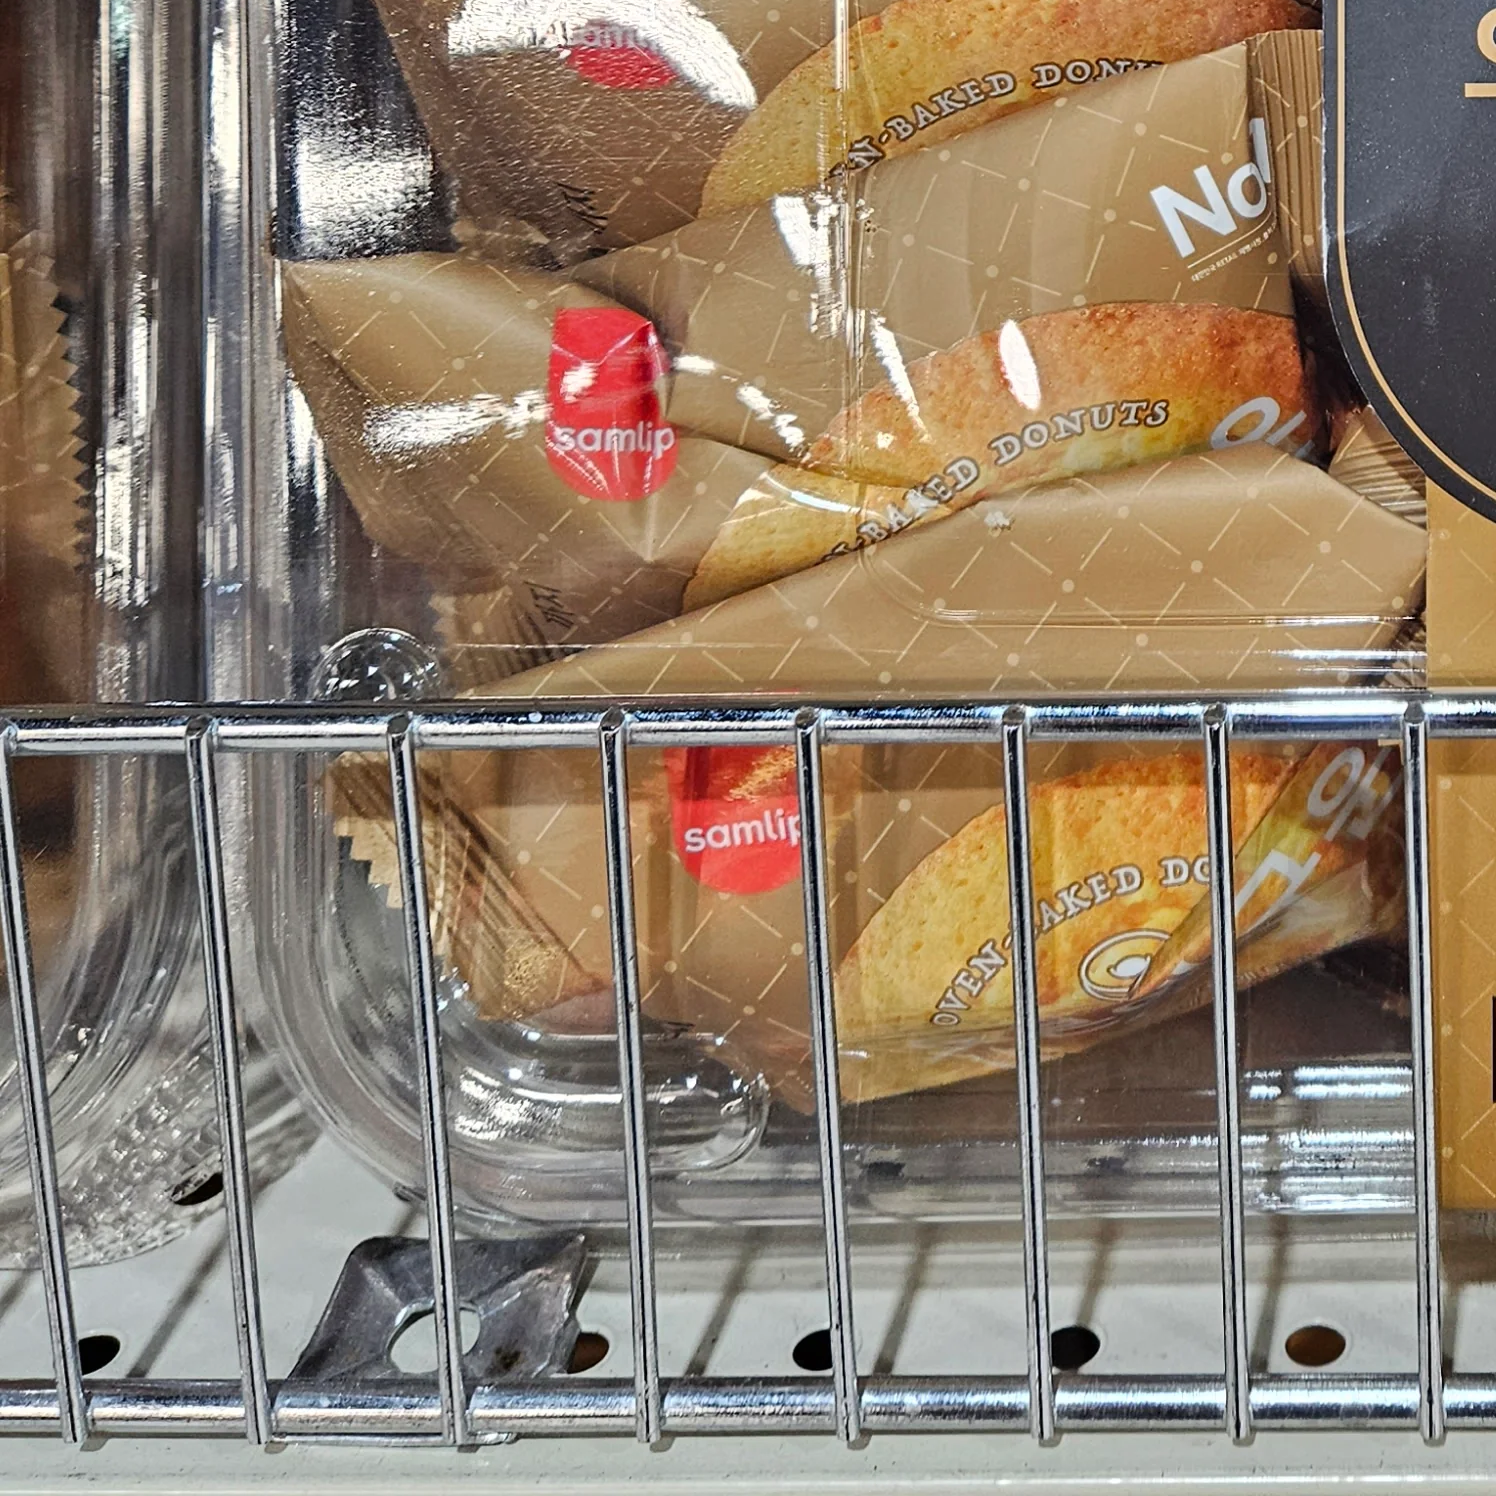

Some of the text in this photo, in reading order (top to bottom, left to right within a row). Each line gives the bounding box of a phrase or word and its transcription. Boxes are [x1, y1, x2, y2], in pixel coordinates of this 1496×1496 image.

[553, 420, 675, 461] samlip
[987, 399, 1170, 467] DONUTS
[683, 807, 801, 853] samlip
[930, 863, 1145, 1028] OVEN-AKED
